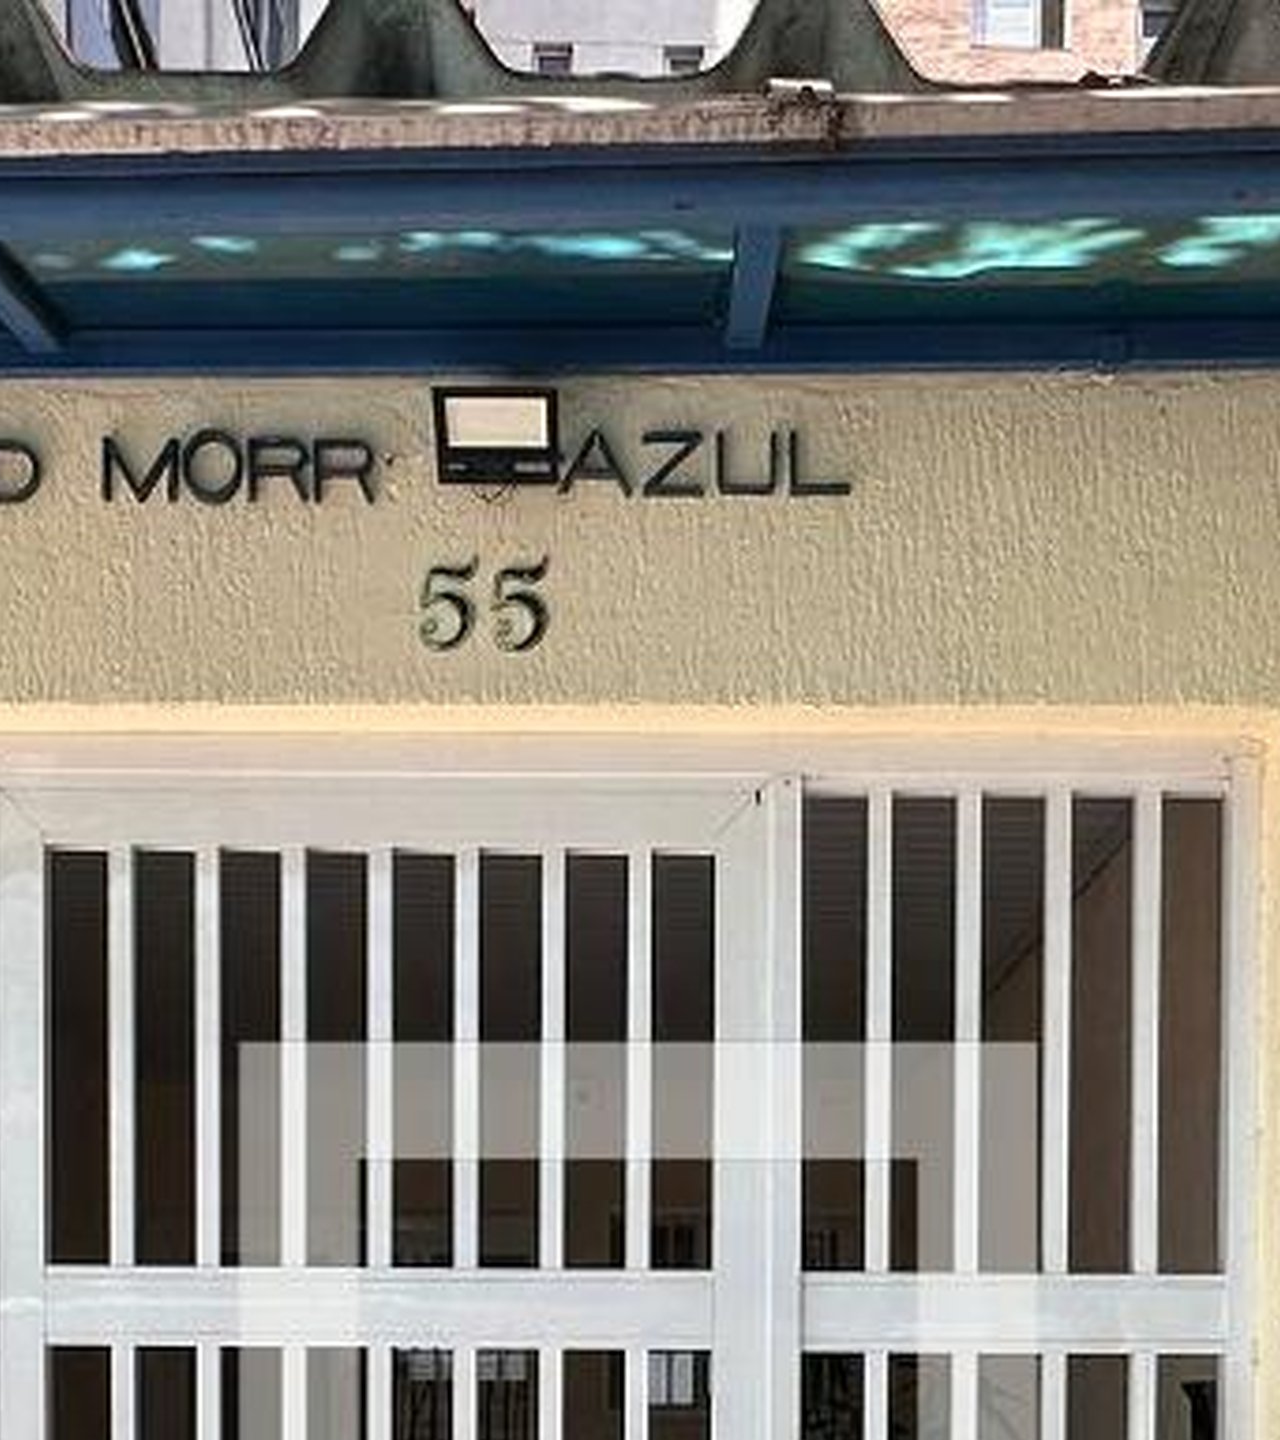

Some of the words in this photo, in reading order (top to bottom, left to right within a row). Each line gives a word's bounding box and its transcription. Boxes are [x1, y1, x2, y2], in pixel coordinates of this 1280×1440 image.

[100, 428, 392, 506] MORR
[556, 429, 853, 498] AZUL
[416, 552, 549, 652] 55
